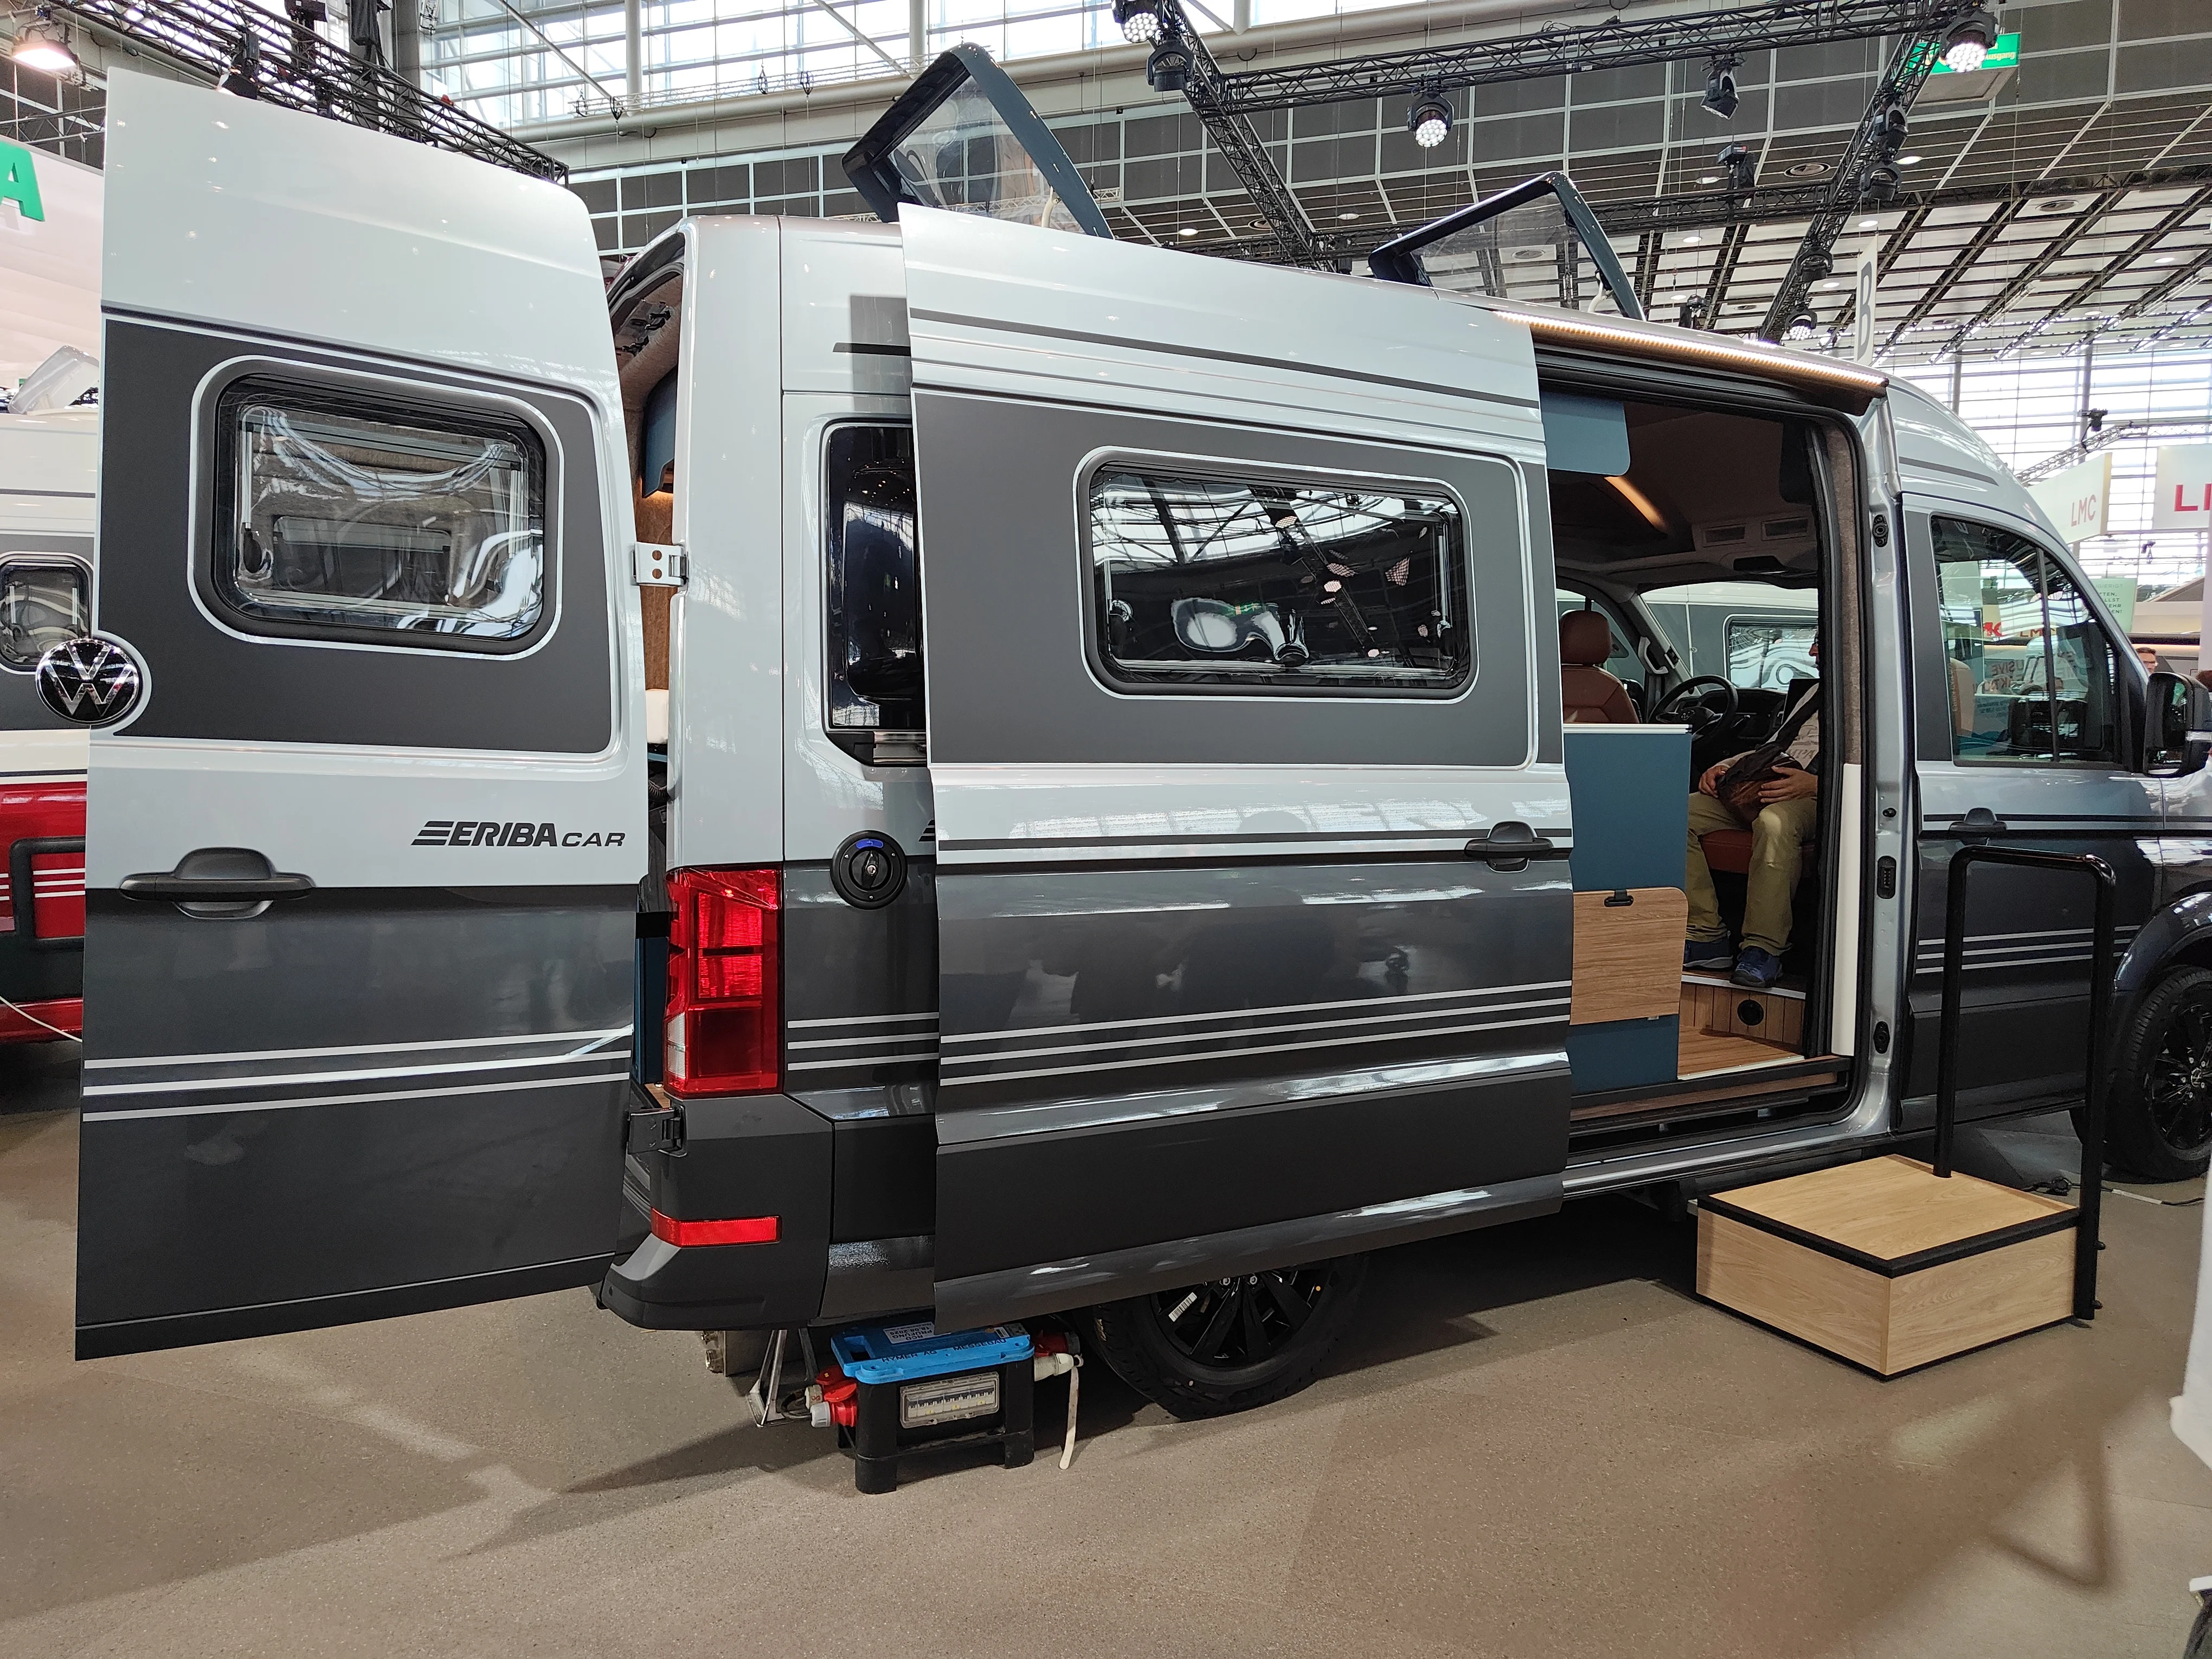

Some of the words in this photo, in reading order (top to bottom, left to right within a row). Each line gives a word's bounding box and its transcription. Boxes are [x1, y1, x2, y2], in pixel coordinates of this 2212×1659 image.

[2070, 494, 2097, 527] LMC
[448, 821, 558, 847] ERIBA
[561, 832, 626, 847] CAR
